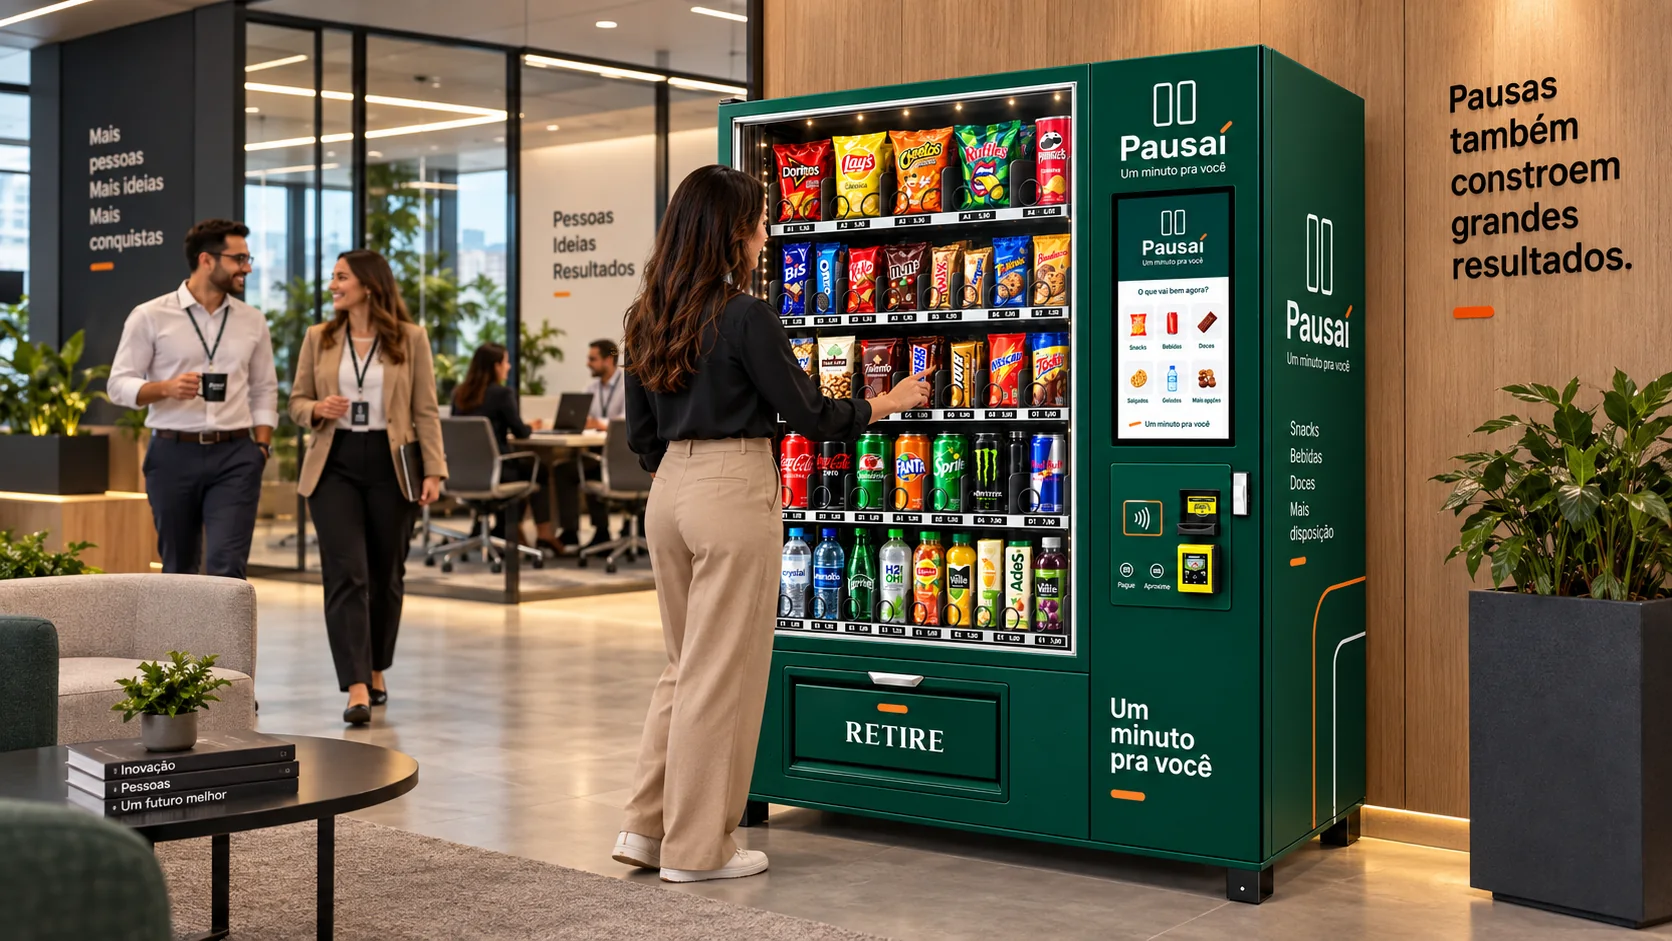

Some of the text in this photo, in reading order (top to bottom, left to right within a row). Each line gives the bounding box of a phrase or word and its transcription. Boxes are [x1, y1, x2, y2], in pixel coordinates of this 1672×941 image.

[1449, 76, 1558, 114] Pausas
[89, 124, 121, 146] Mais
[1120, 120, 1233, 162] Pausaí
[1450, 113, 1579, 155] também
[89, 150, 145, 175] pessoas
[1120, 161, 1226, 179] Um minuto pra você
[89, 173, 164, 199] Mais ideias
[1451, 156, 1621, 197] constroem
[89, 204, 121, 225] Mais
[553, 210, 615, 228] Pessoas
[1451, 201, 1580, 245] grandes
[89, 228, 164, 253] conquistas
[553, 234, 597, 254] Ideias
[1142, 233, 1208, 256] Pausaí
[553, 258, 636, 280] Resultados
[1453, 241, 1633, 280] resultados.
[1185, 286, 1209, 295] agora?
[1286, 299, 1353, 348] Pausaí
[1286, 351, 1350, 372] Um minuto pra você
[1157, 420, 1180, 428] minuto
[1194, 420, 1210, 428] você
[1290, 420, 1320, 438] Snacks
[1290, 447, 1323, 464] Bebidas
[1290, 474, 1316, 490] Doces
[1290, 501, 1310, 517] Mais
[1289, 524, 1335, 544] disposição
[1010, 552, 1025, 592] AdeS
[1117, 581, 1136, 590] Pague
[1143, 582, 1171, 591] Aproxime
[1110, 697, 1149, 721] Um
[845, 720, 945, 753] RETIRE
[1110, 723, 1195, 751] minuto
[121, 760, 176, 775] Inovação
[1110, 751, 1213, 778] pra você
[121, 779, 171, 794] Pessoas
[121, 789, 227, 811] Um futuro melhor
